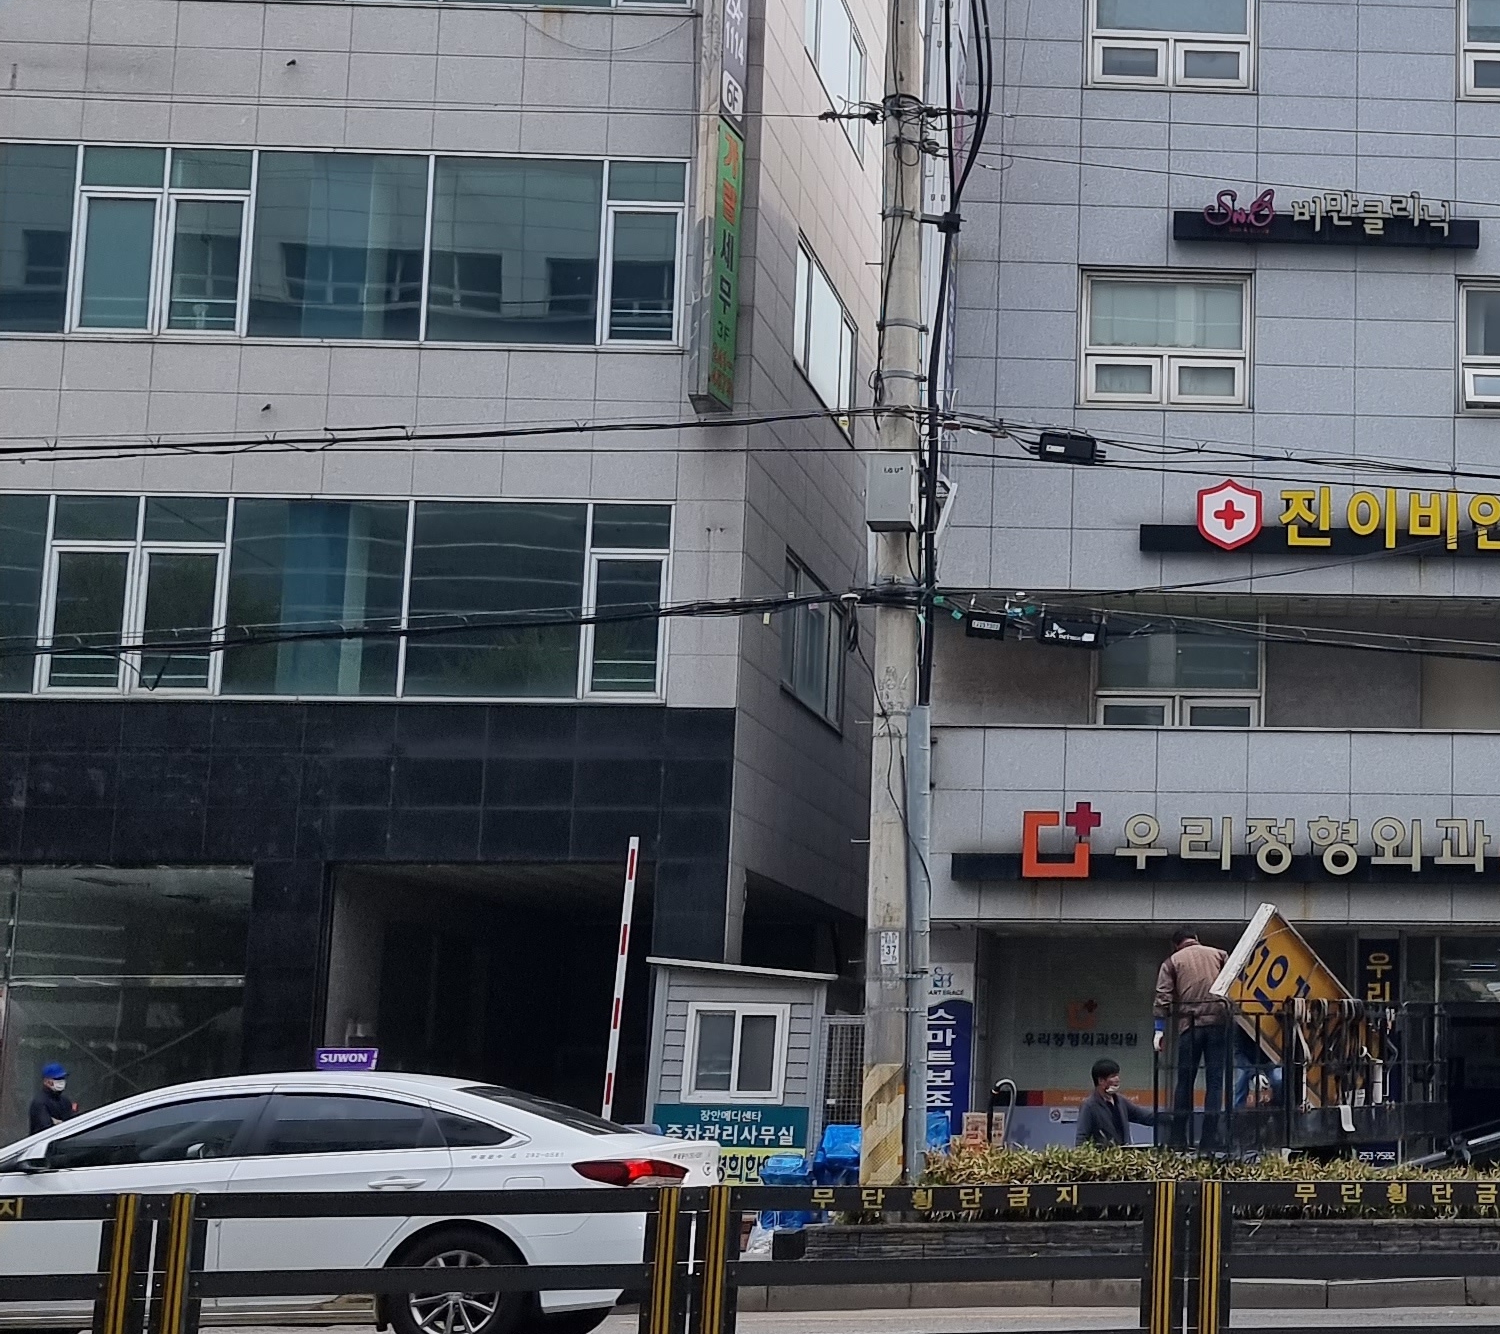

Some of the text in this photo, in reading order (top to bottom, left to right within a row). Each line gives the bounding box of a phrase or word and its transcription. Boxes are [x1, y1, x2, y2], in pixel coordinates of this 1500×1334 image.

[1291, 189, 1452, 237] 비만클리닉
[1114, 813, 1491, 875] 우리정형외과
[319, 1052, 369, 1064] SUWON
[926, 1007, 956, 1123] 스마트보조
[664, 1123, 794, 1146] 주차관리사무실
